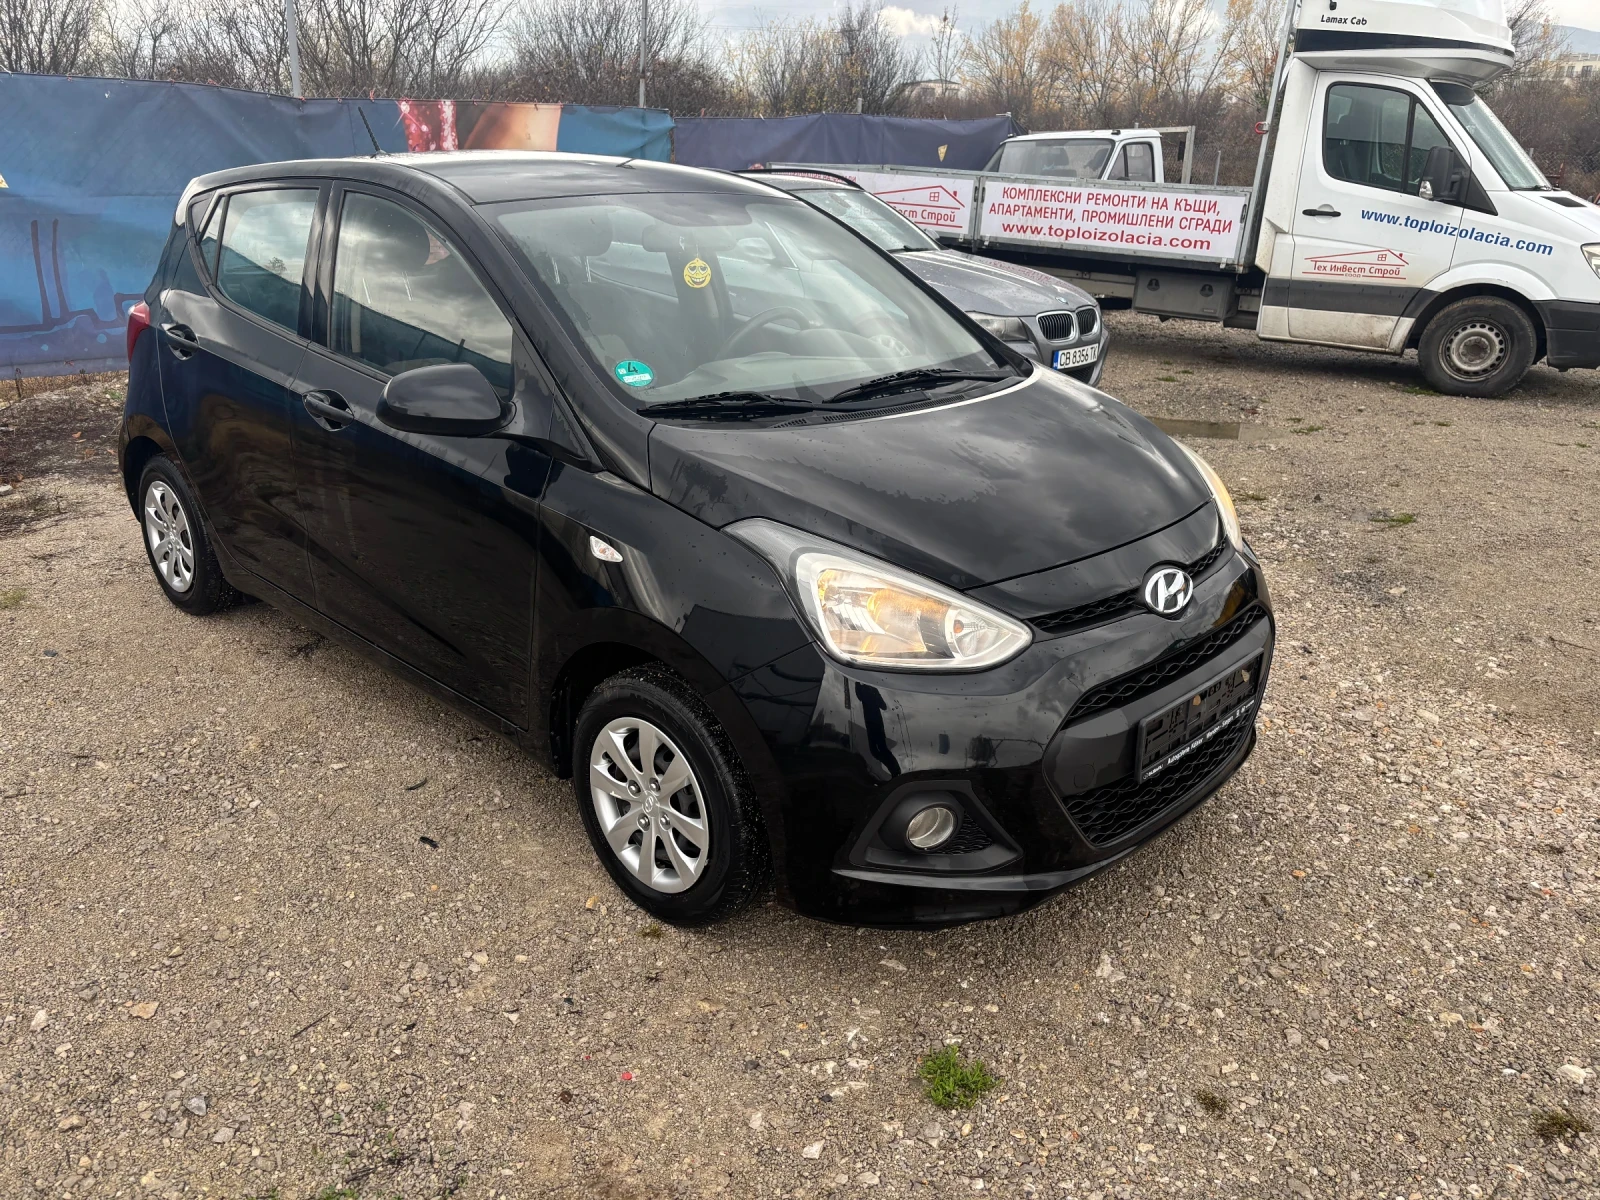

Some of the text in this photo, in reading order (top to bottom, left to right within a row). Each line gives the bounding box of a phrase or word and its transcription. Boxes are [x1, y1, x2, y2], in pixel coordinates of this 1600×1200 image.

[1320, 14, 1368, 25] Lamax Cab
[1002, 186, 1221, 216] КОМПЛЕКСНИ РЕМОНТИ НА КЪЩИ,
[921, 209, 956, 225] Строй
[989, 203, 1233, 234] АПАРТАМЕНТИ, ПРОМИШЛЕНИ СГРАДИ
[1001, 222, 1211, 251] www.toploizolacia.com
[1361, 209, 1554, 257] www.toploizolacia.com
[1313, 261, 1328, 272] Тех
[1368, 266, 1401, 278] Строй
[1072, 349, 1089, 364] 8356
